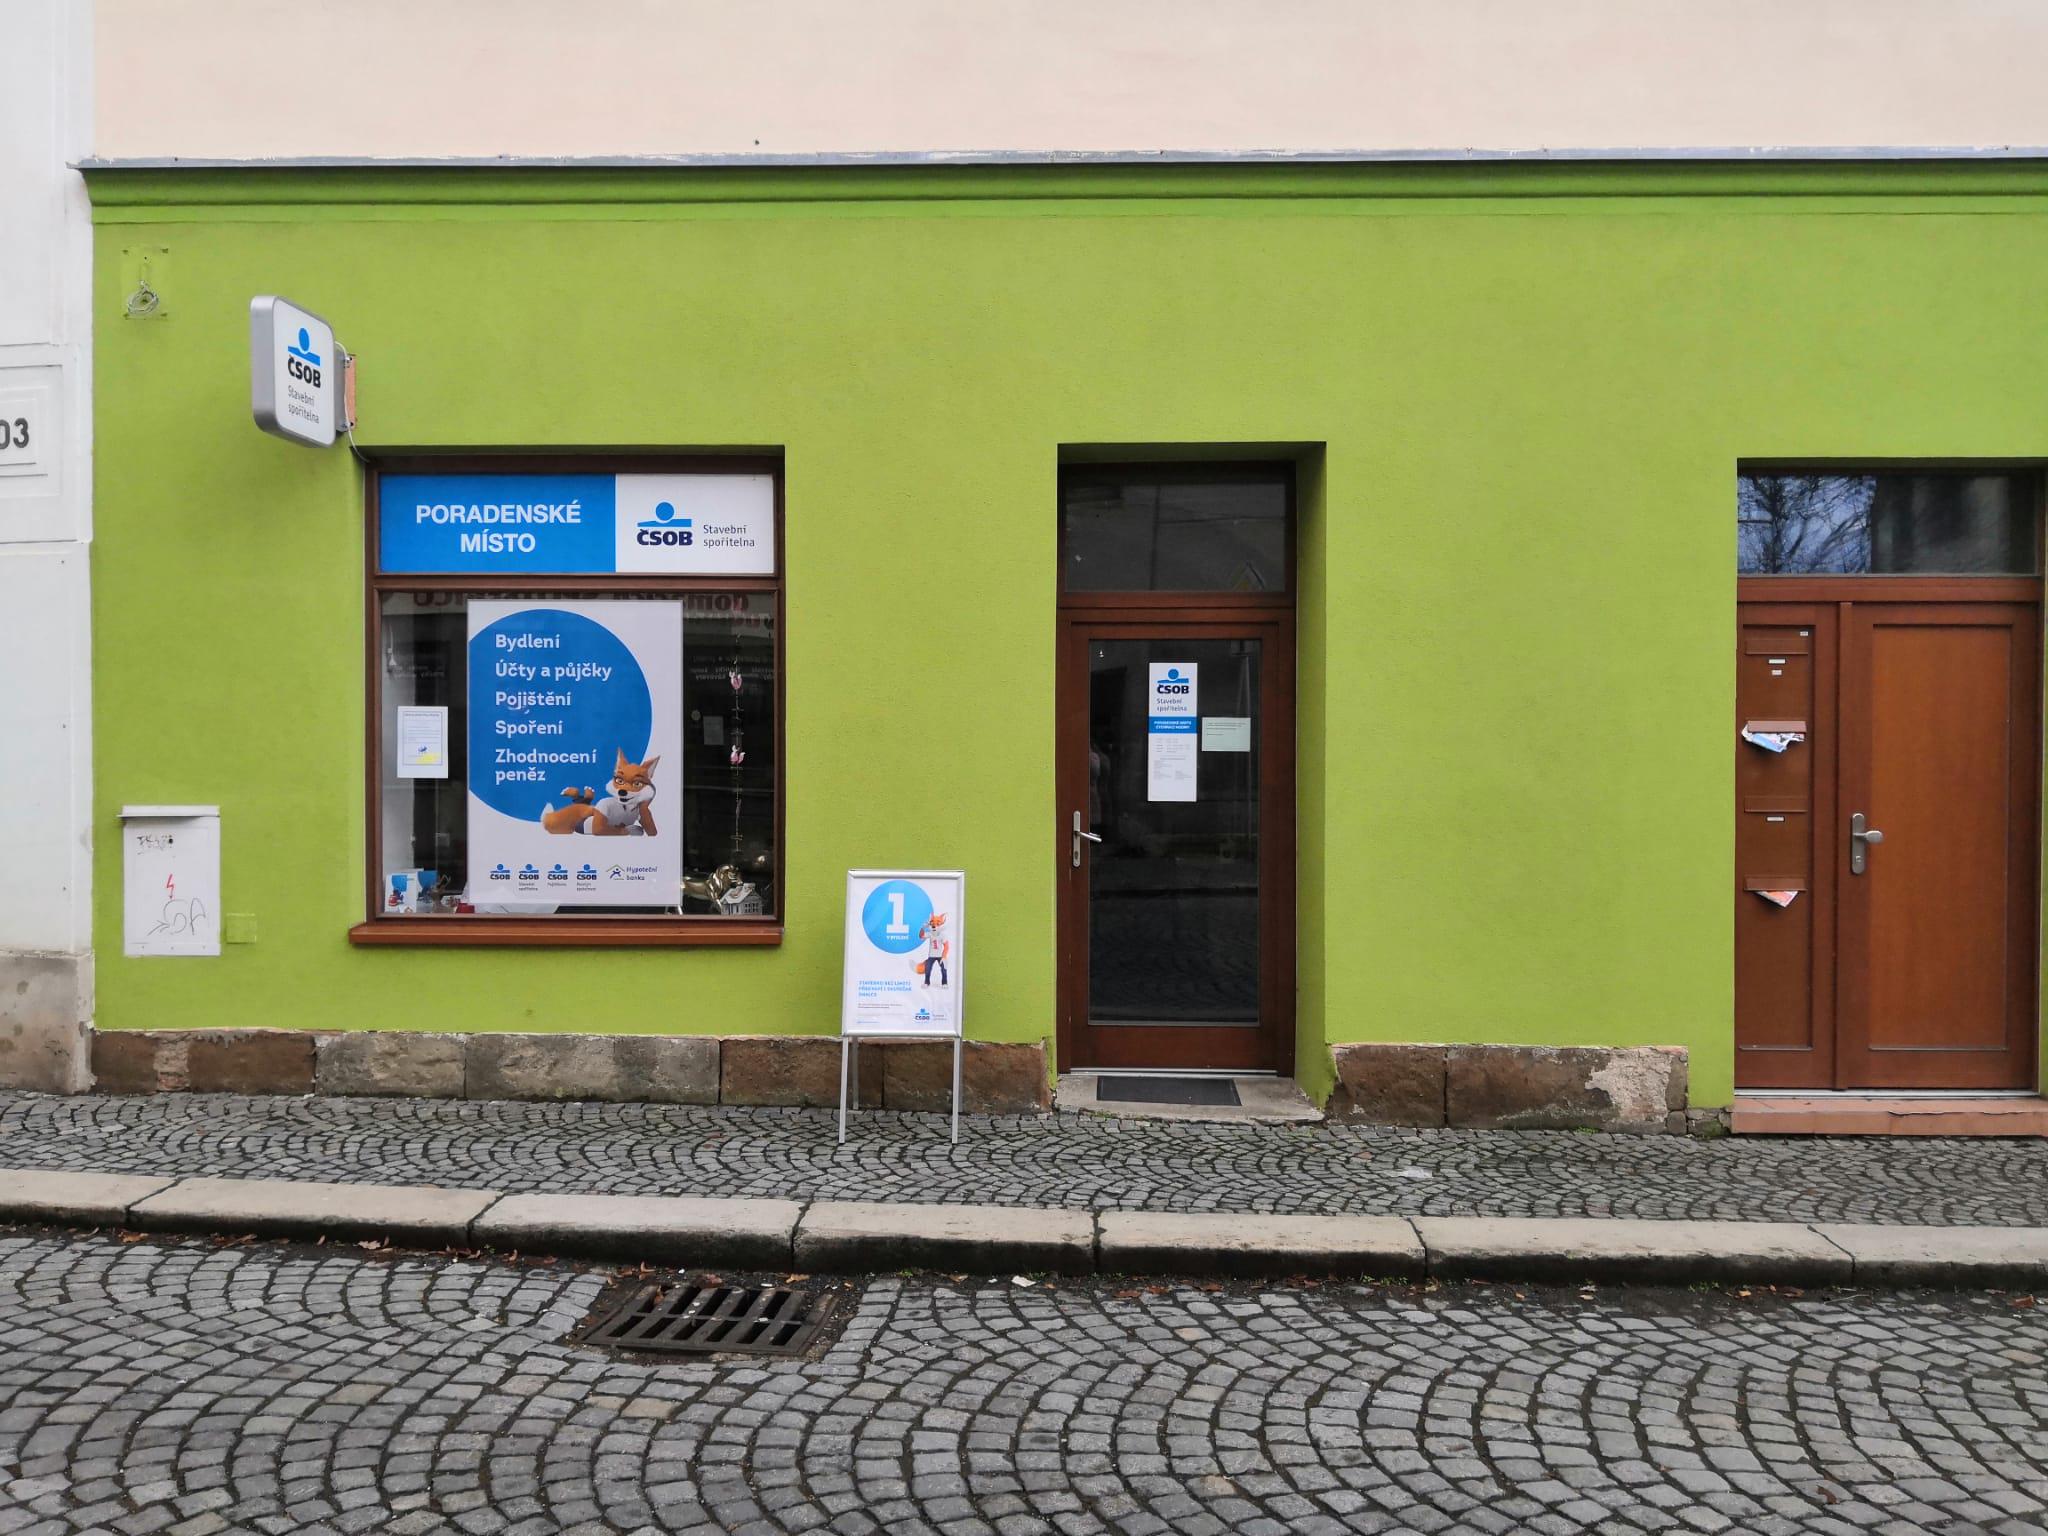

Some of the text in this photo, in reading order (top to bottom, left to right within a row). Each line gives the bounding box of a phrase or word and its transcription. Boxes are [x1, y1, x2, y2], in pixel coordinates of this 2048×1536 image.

[288, 354, 321, 389] ČSOB
[288, 385, 315, 406] Stavební
[288, 403, 320, 424] spořitelna
[416, 499, 582, 525] PORADENSKÉ
[636, 527, 693, 546] ČSOB
[703, 523, 747, 535] Stavební
[460, 528, 536, 553] MÍSTO
[703, 535, 755, 548] spořitelna
[495, 633, 560, 653] Bydlení
[495, 658, 612, 682] Účty a půjčky
[1157, 684, 1190, 695] ČSOB
[495, 691, 572, 711] Pojištění
[495, 719, 563, 739] Spoření
[495, 748, 597, 764] Zhodnocení
[495, 766, 546, 786] peněz
[886, 892, 909, 933] 1
